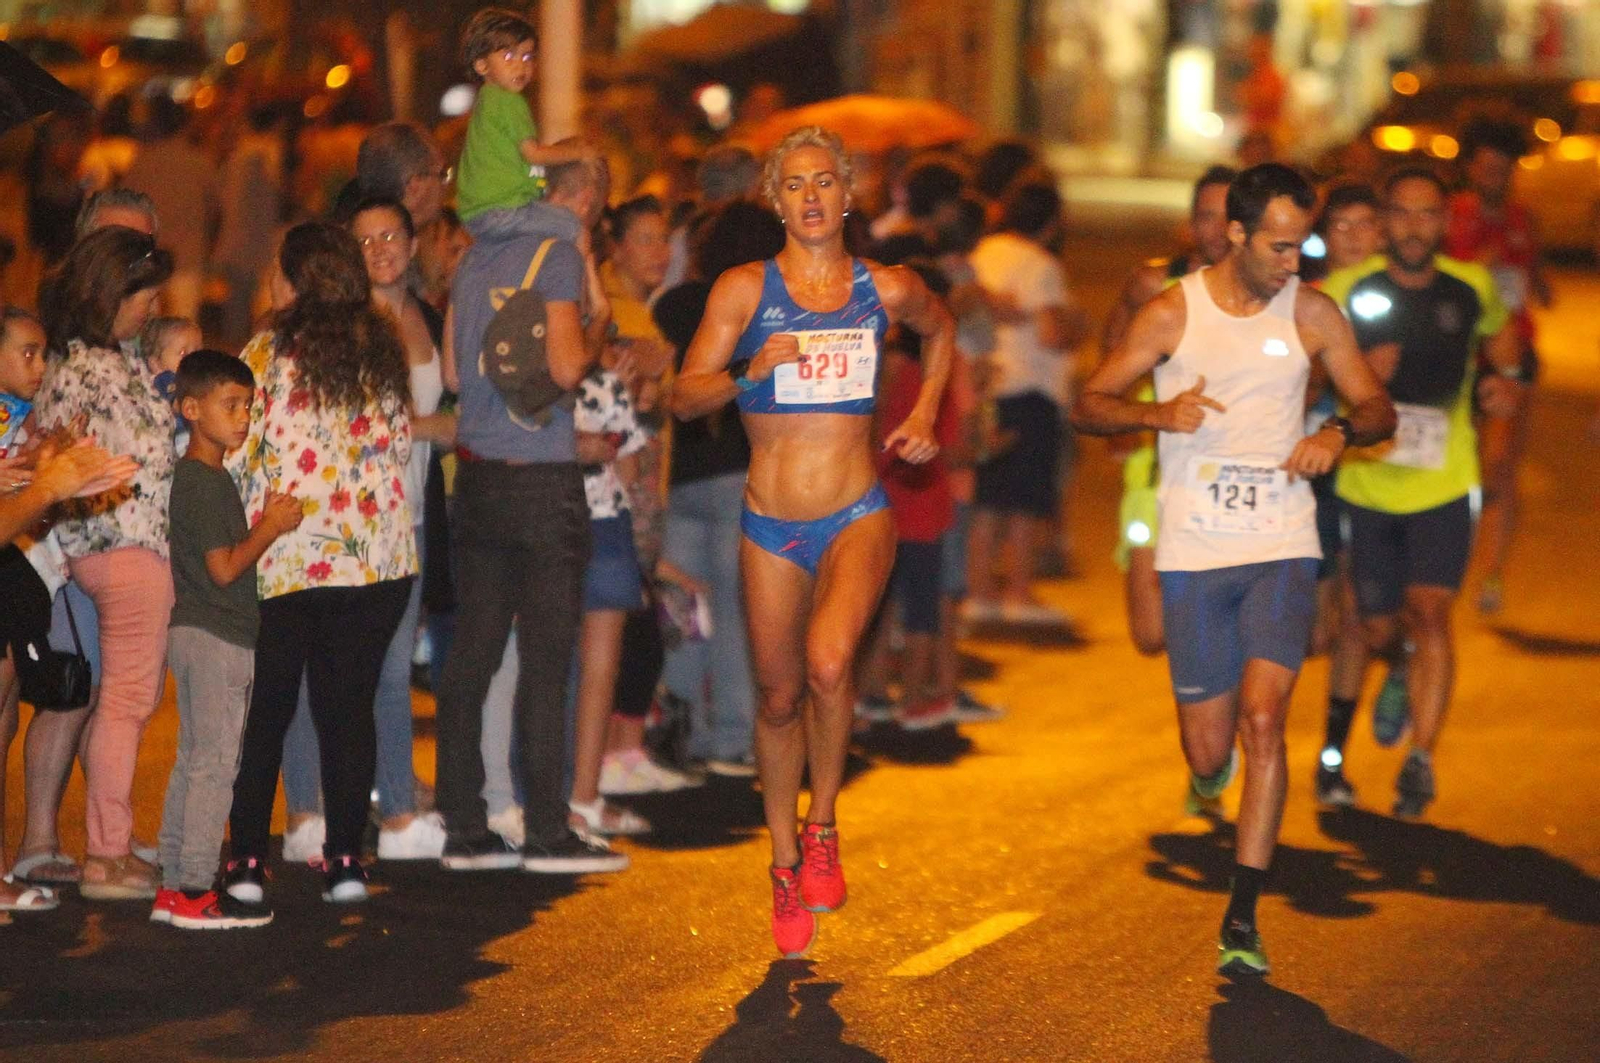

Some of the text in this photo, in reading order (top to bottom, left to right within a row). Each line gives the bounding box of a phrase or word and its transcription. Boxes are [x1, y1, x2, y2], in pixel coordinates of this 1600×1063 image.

[808, 333, 863, 343] NOCTURNA
[824, 342, 862, 352] HUELVA
[798, 353, 848, 380] 629
[1207, 483, 1257, 510] 124
